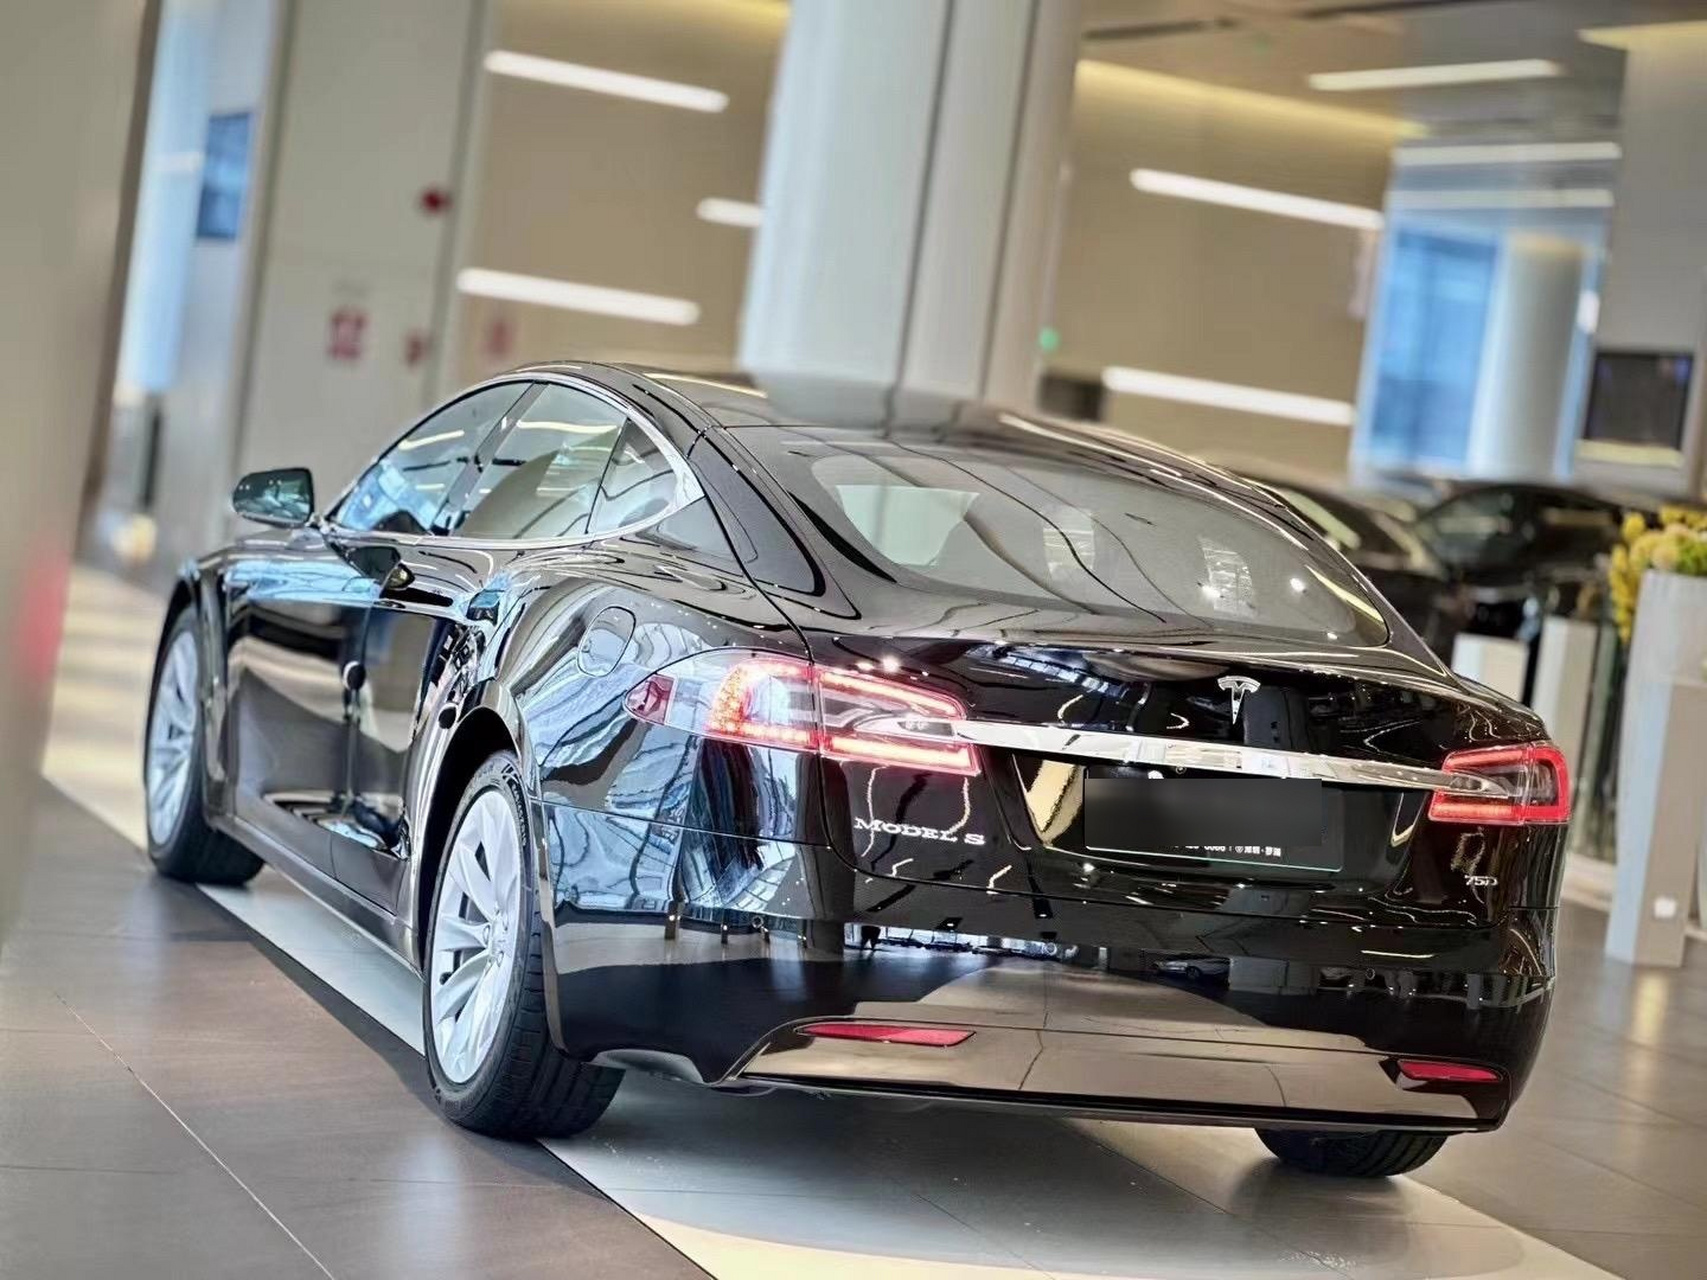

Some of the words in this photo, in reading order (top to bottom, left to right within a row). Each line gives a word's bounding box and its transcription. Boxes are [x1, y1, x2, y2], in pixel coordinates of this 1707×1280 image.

[853, 817, 958, 842] MODEL
[964, 833, 986, 845] S
[1464, 874, 1498, 887] 75D
